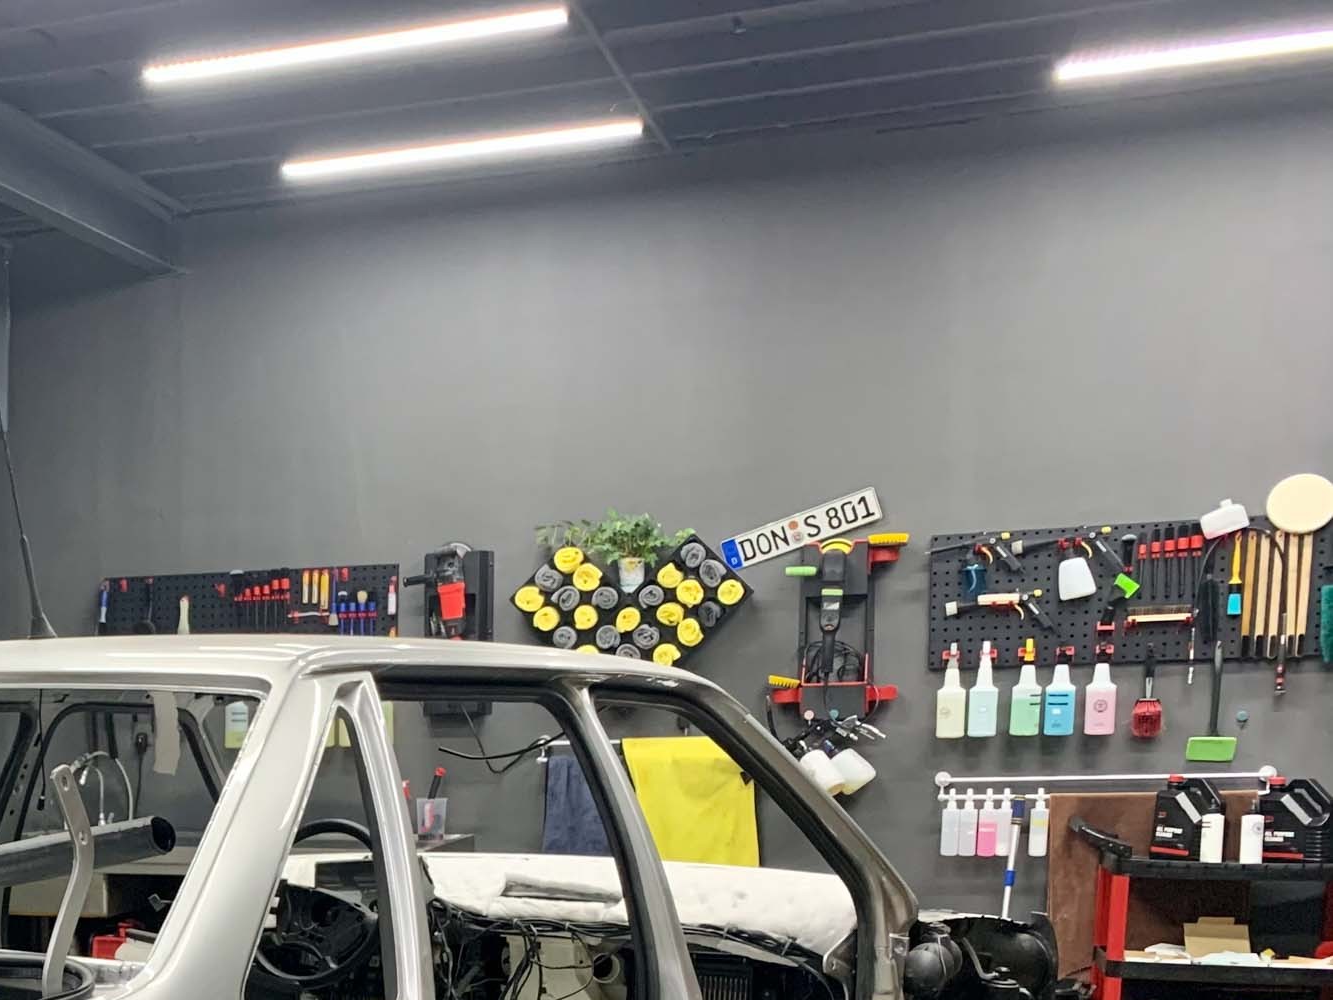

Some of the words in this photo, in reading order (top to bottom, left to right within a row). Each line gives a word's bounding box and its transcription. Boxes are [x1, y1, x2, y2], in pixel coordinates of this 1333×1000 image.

[738, 525, 790, 562] DON
[804, 515, 821, 538] S
[826, 495, 876, 530] 801
